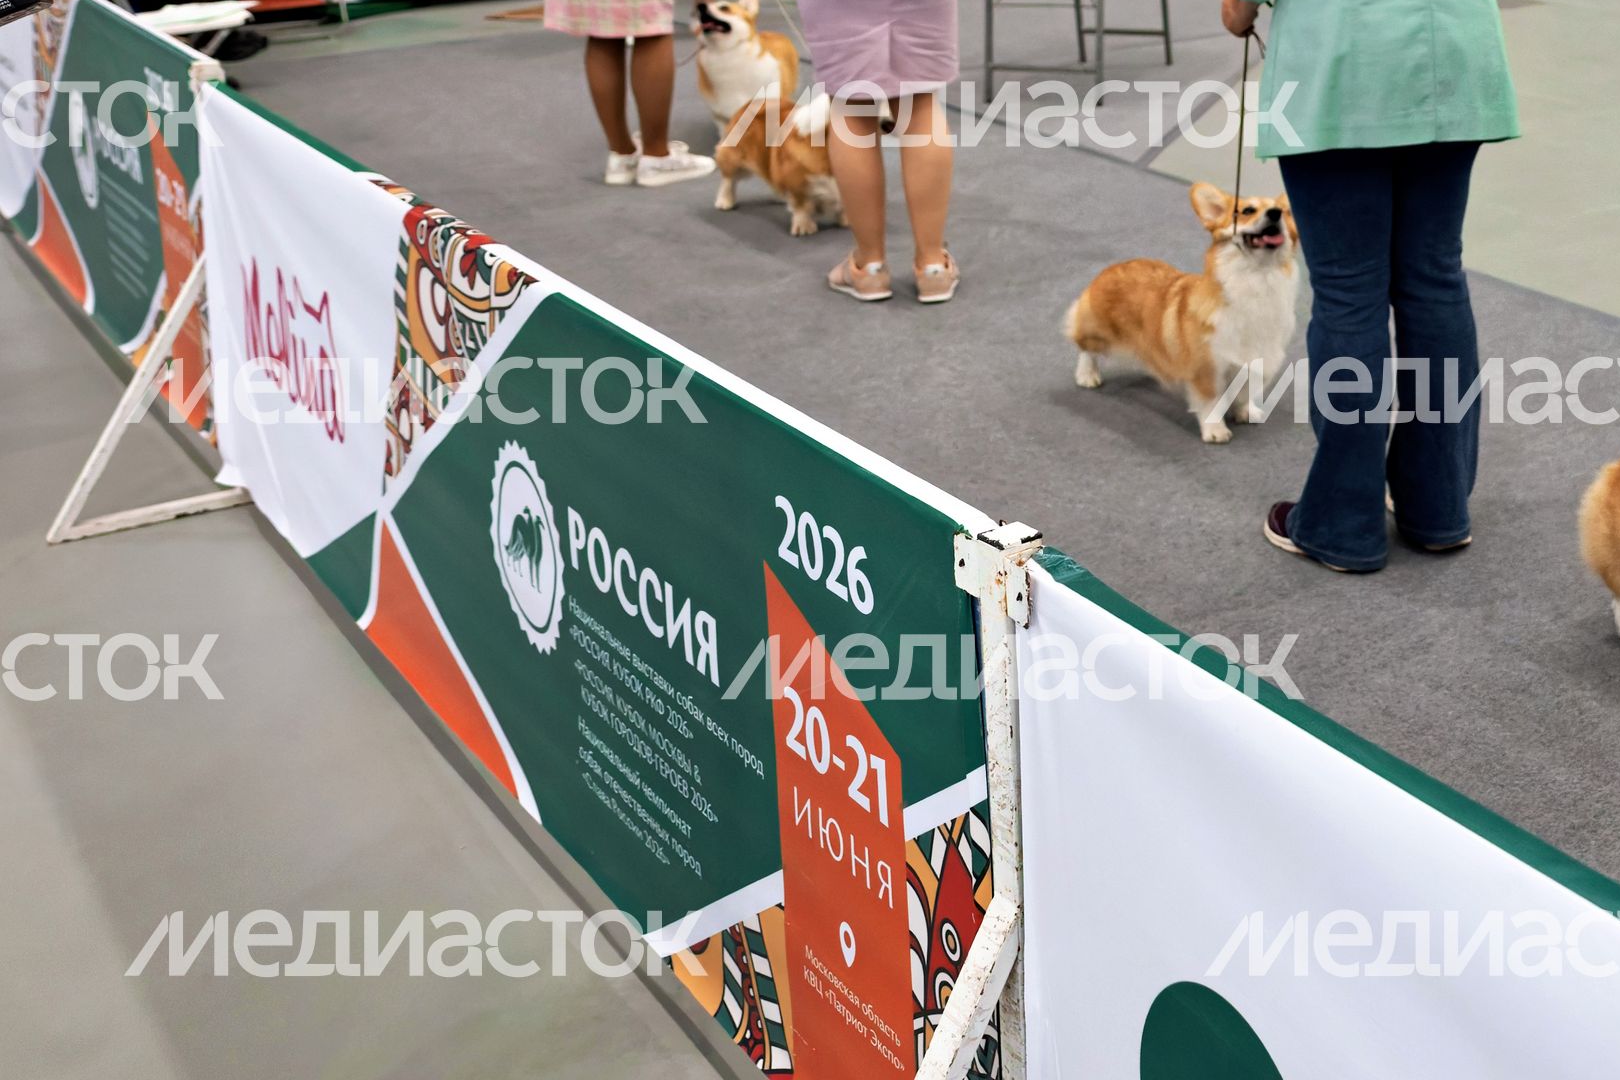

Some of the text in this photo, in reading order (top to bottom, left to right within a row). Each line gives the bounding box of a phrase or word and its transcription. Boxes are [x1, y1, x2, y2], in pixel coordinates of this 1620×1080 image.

[240, 255, 345, 444] Molina
[567, 506, 721, 687] РОССИЯ
[774, 494, 874, 615] 2026
[569, 595, 765, 780] Национальные выставки собак всех пород
[613, 658, 644, 700] КУБОК
[645, 686, 665, 715] РКФ
[667, 705, 694, 740] 2026»
[616, 694, 649, 736] КУБОК
[649, 723, 692, 777] МОСКВЫ
[690, 786, 719, 823] 2026»
[783, 686, 889, 828] 20-21
[641, 782, 692, 839] чемпионат
[671, 837, 703, 880] пород
[793, 786, 894, 910] ИЮНЯ
[803, 965, 905, 1071] КВЦ «Патриот Экспо»
[804, 944, 901, 1047] Московская область
